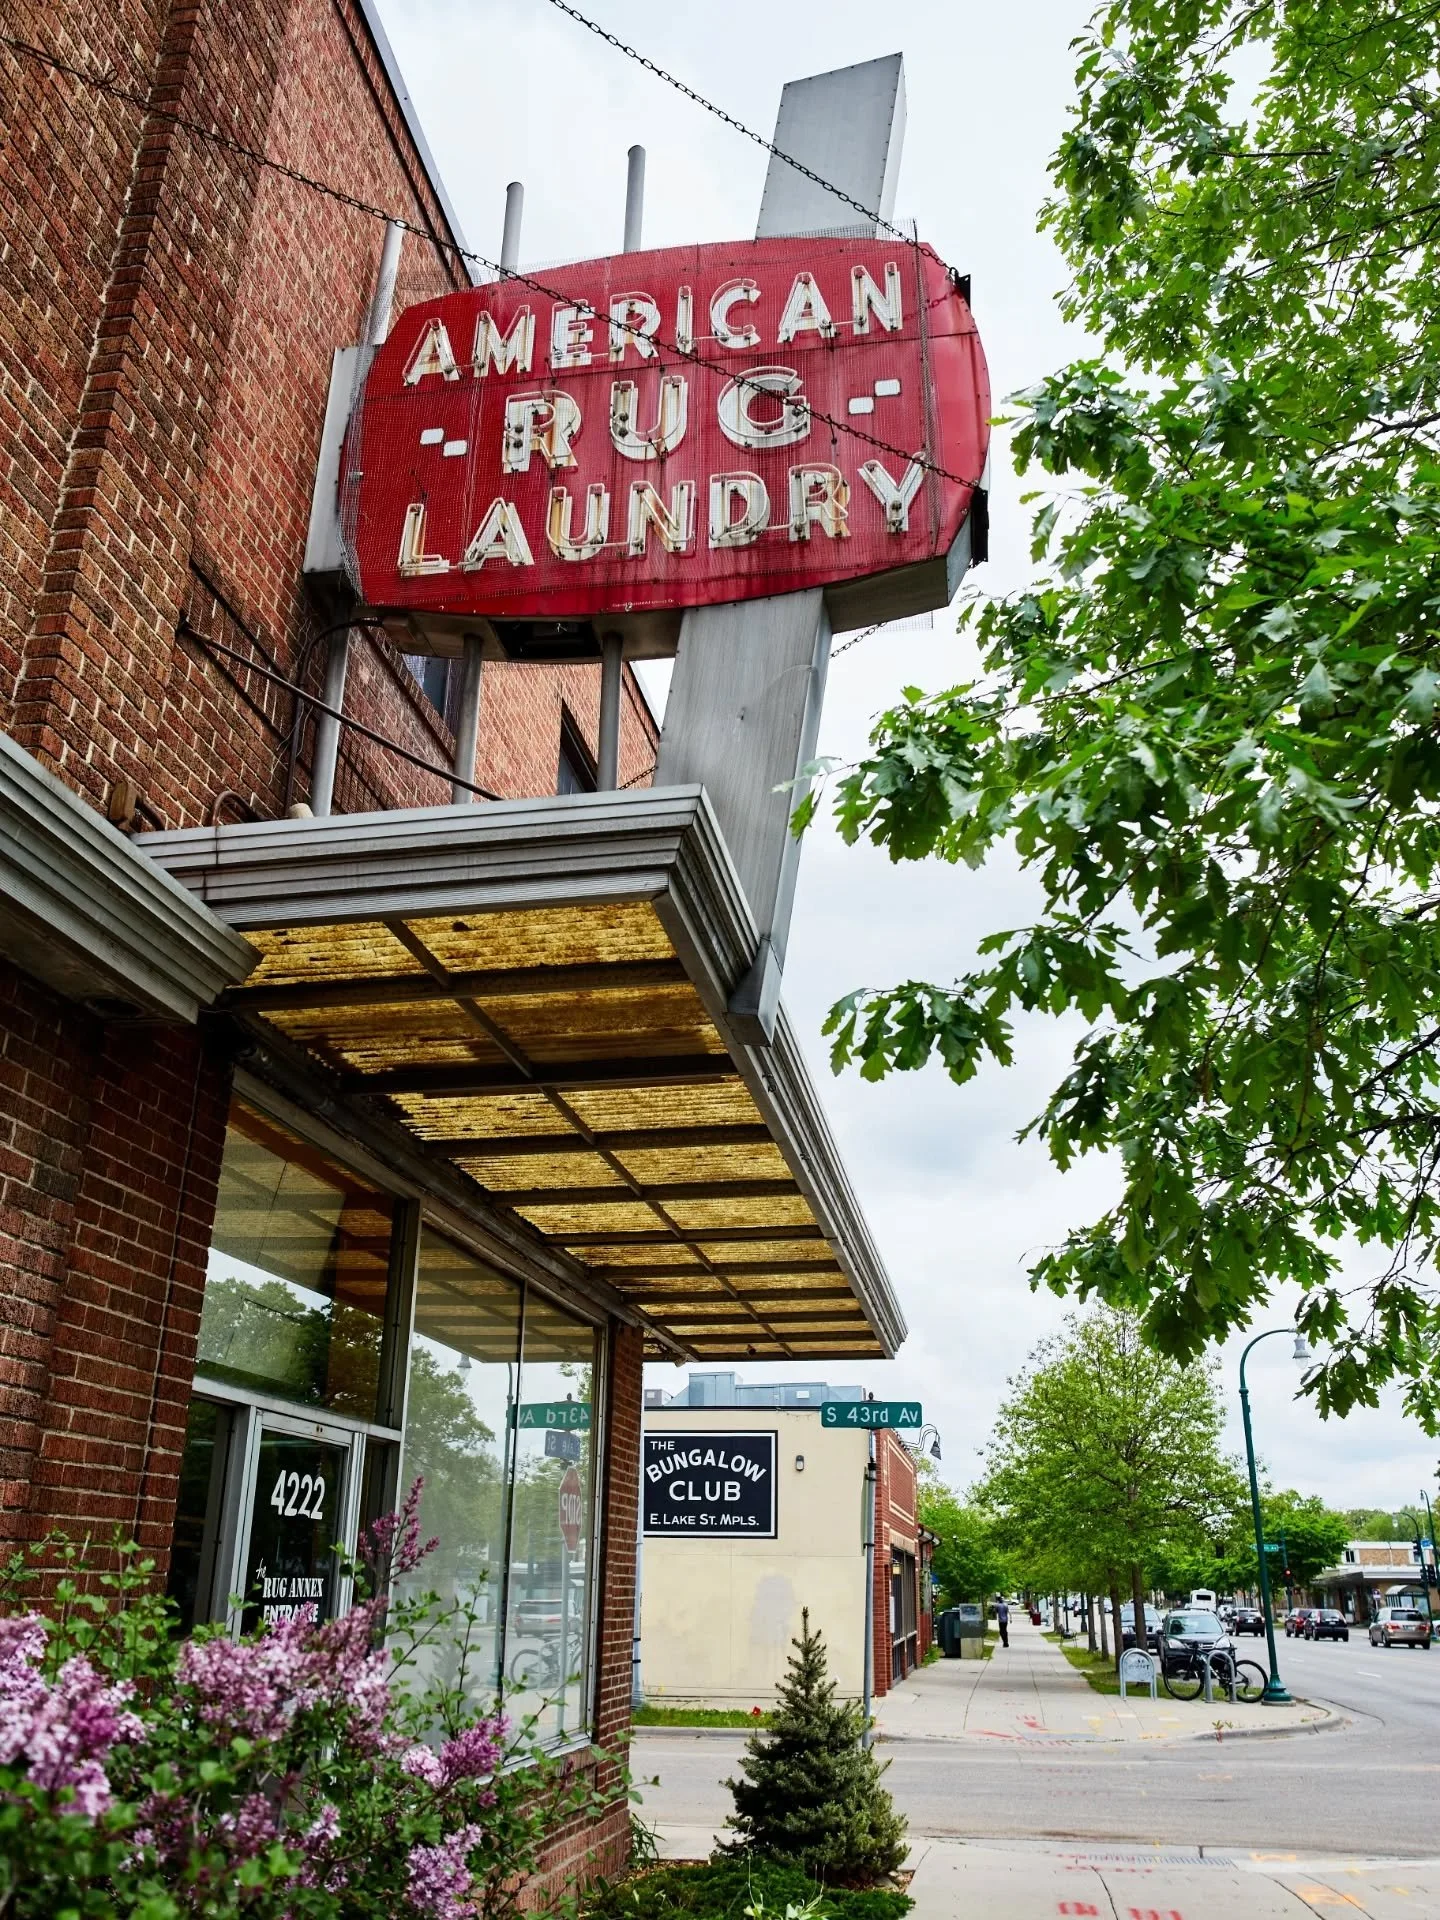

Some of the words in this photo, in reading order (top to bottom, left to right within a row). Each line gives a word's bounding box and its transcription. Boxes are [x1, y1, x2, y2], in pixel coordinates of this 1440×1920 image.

[402, 262, 903, 386] AMERICAN
[502, 366, 812, 474] RUG
[398, 451, 927, 577] LAUNDRY
[826, 1407, 837, 1423] S
[847, 1407, 889, 1423] 43rd
[898, 1407, 919, 1423] Av
[650, 1440, 676, 1451] THE
[646, 1448, 767, 1483] BUNGALOW
[271, 1470, 326, 1520] 4222
[668, 1480, 742, 1502] CLUB
[649, 1513, 662, 1526] E.
[663, 1514, 696, 1526] LAKE
[720, 1513, 760, 1527] MPLS.
[262, 1577, 288, 1599] RUG
[288, 1577, 325, 1598] ANNEX
[262, 1603, 319, 1626] ENTRAE
